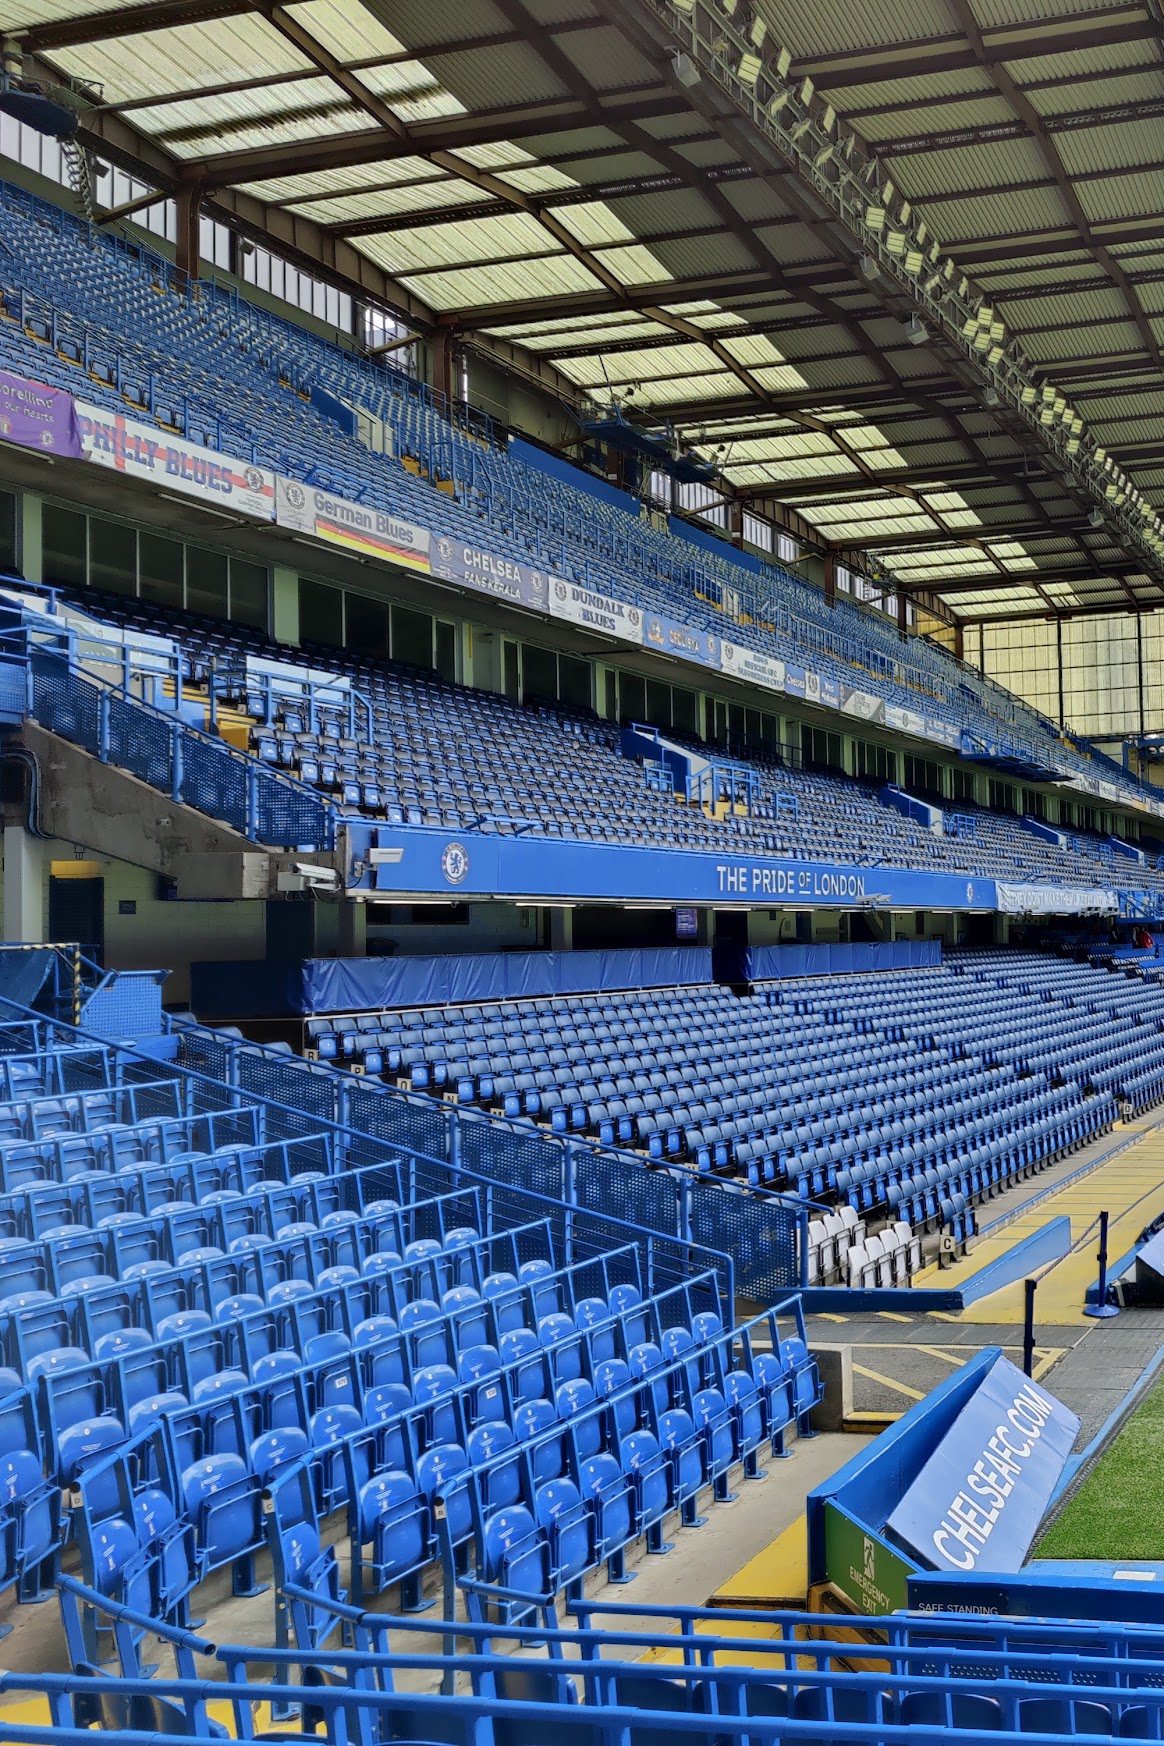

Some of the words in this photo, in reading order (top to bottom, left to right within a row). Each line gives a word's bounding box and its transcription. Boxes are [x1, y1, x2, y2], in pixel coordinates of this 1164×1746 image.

[78, 414, 160, 470] PHILLY
[165, 446, 234, 495] BLUES
[314, 491, 373, 530] German
[375, 513, 414, 544] Blues
[463, 547, 522, 583] CHELSEA
[464, 570, 487, 588] FANS
[487, 580, 521, 600] KERALA
[571, 587, 626, 619] DUNDALK
[581, 607, 616, 631] BLUES
[717, 865, 747, 892] THE
[752, 868, 795, 894] PRIDE
[799, 871, 811, 888] OF
[814, 872, 865, 897] LONDON
[308, 1051, 314, 1059] R
[447, 1095, 454, 1103] N
[1125, 1105, 1131, 1113] D
[943, 1238, 951, 1250] C
[932, 1383, 1055, 1571] CHELSEAFC.COM
[849, 1565, 890, 1610] EMERGENCY
[862, 1592, 877, 1615] EXIT
[918, 1602, 944, 1612] SAFE
[946, 1604, 998, 1615] STANDING
